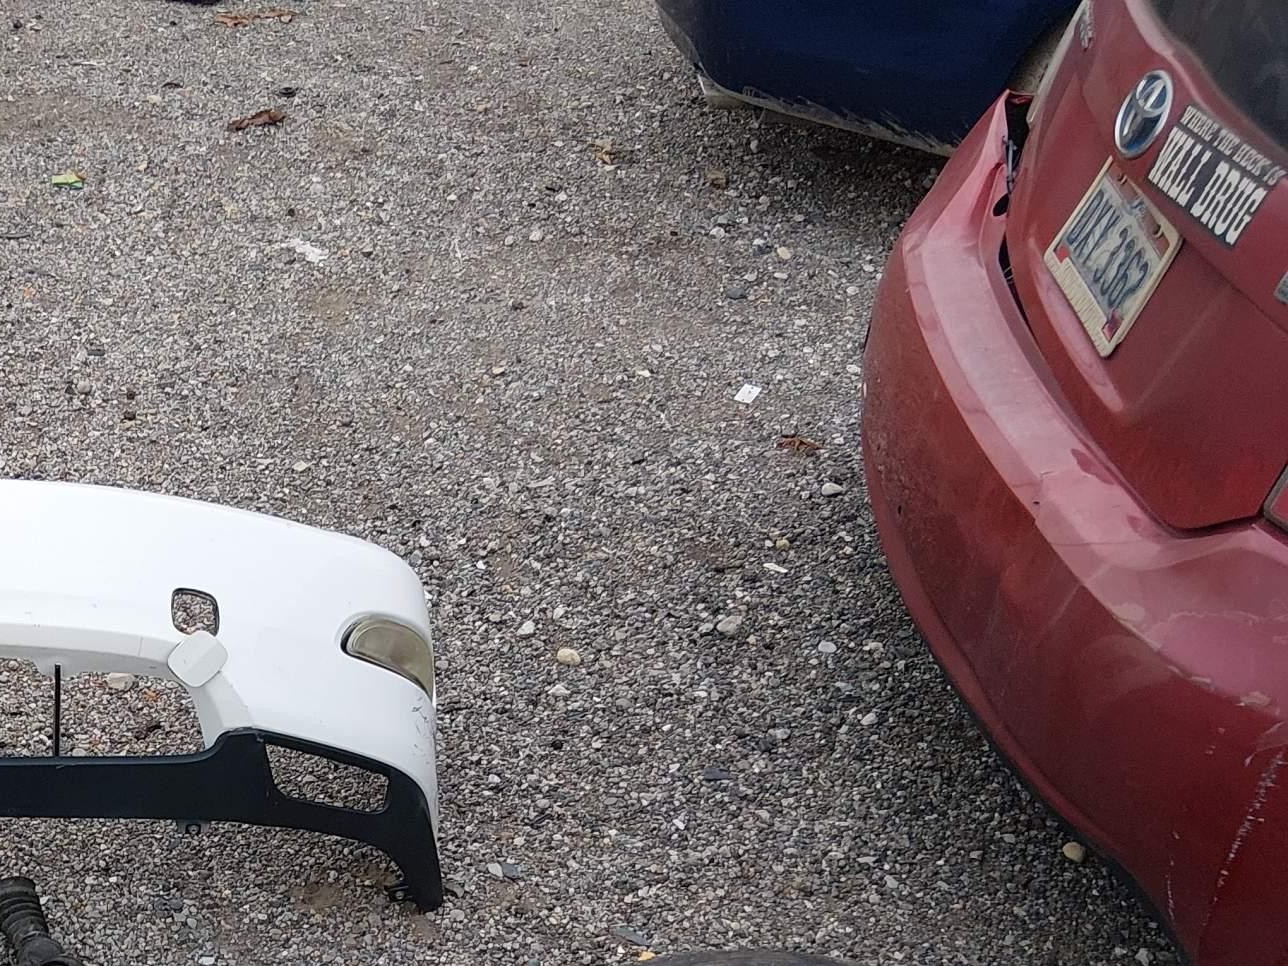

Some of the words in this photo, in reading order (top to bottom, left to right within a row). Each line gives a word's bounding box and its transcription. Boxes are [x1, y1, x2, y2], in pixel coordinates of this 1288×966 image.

[1149, 127, 1211, 206] WALL
[1192, 163, 1269, 245] DRUG
[1180, 106, 1220, 138] WHERE
[1213, 127, 1241, 154] THE
[1234, 141, 1275, 174] HECK
[1264, 165, 1287, 186] IS
